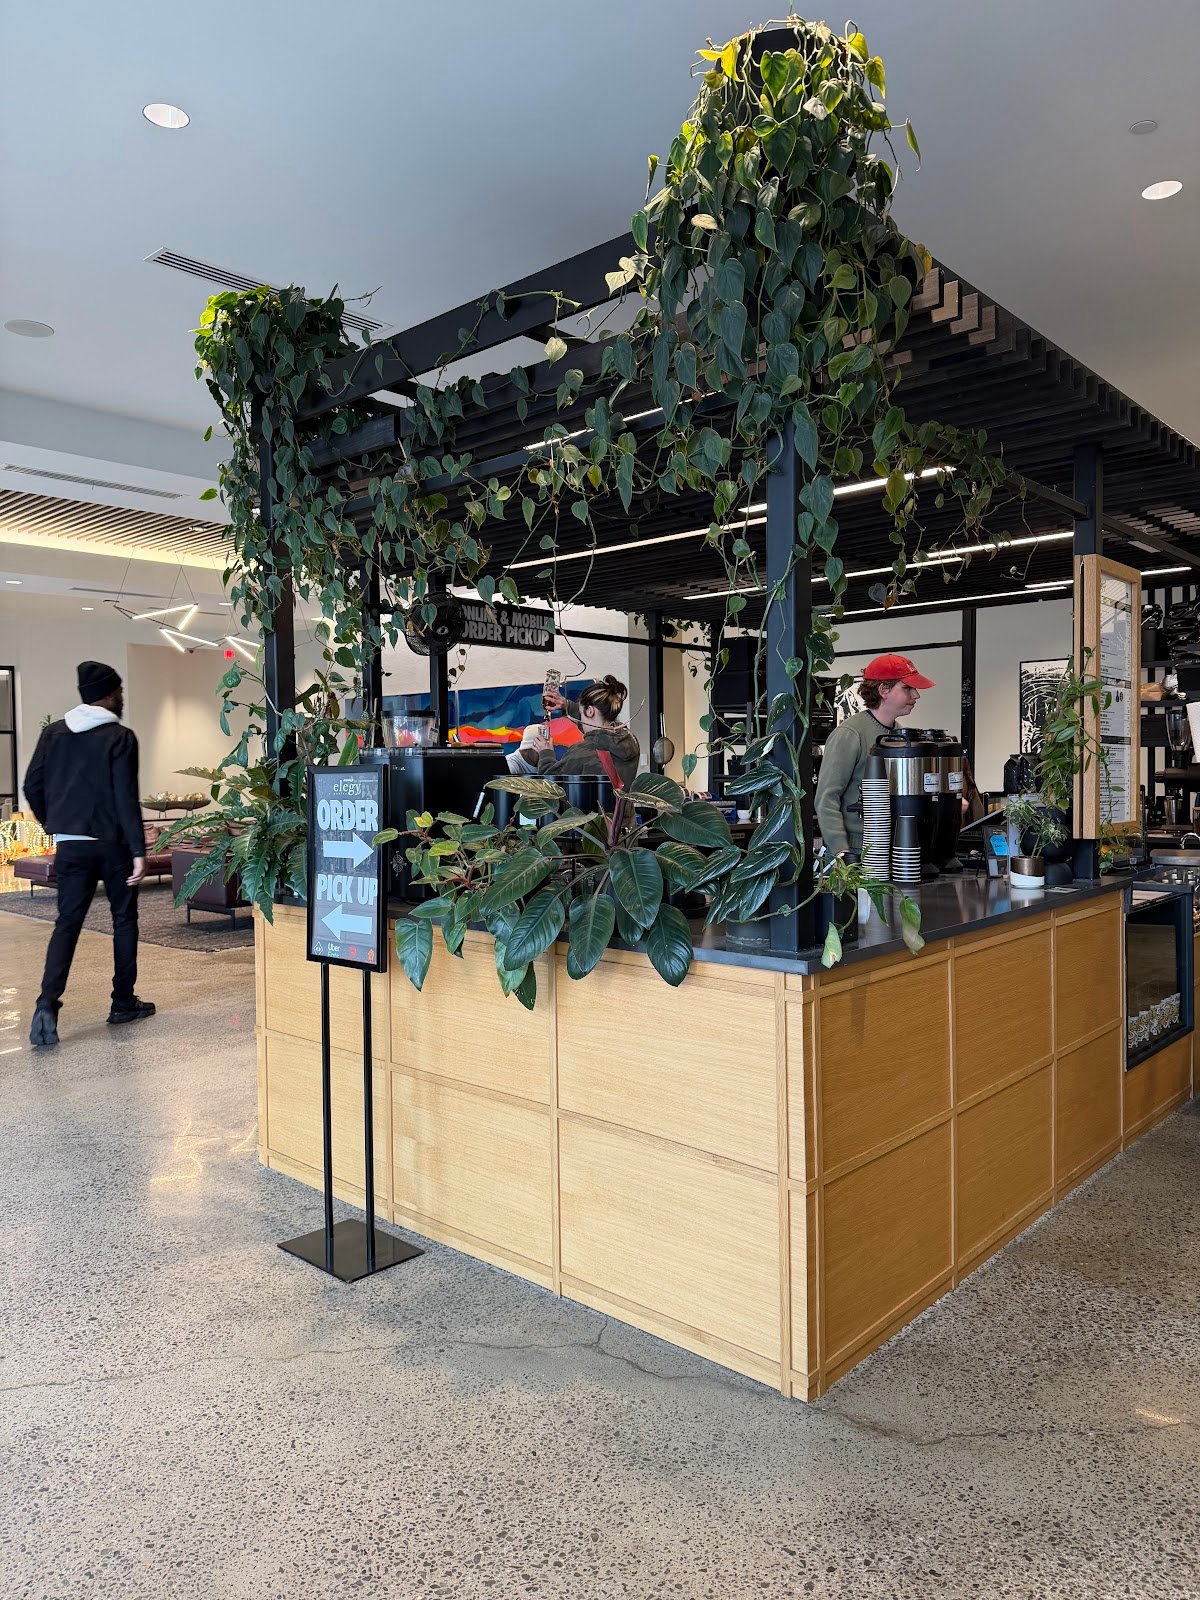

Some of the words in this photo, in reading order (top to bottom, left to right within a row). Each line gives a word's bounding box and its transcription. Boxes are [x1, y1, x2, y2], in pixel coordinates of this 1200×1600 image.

[500, 610, 510, 626] &
[505, 625, 550, 647] PICKUP
[333, 779, 362, 796] elegy
[317, 798, 379, 832] ORDER
[316, 873, 354, 904] PICK
[357, 876, 379, 906] UP
[327, 942, 341, 952] Uber
